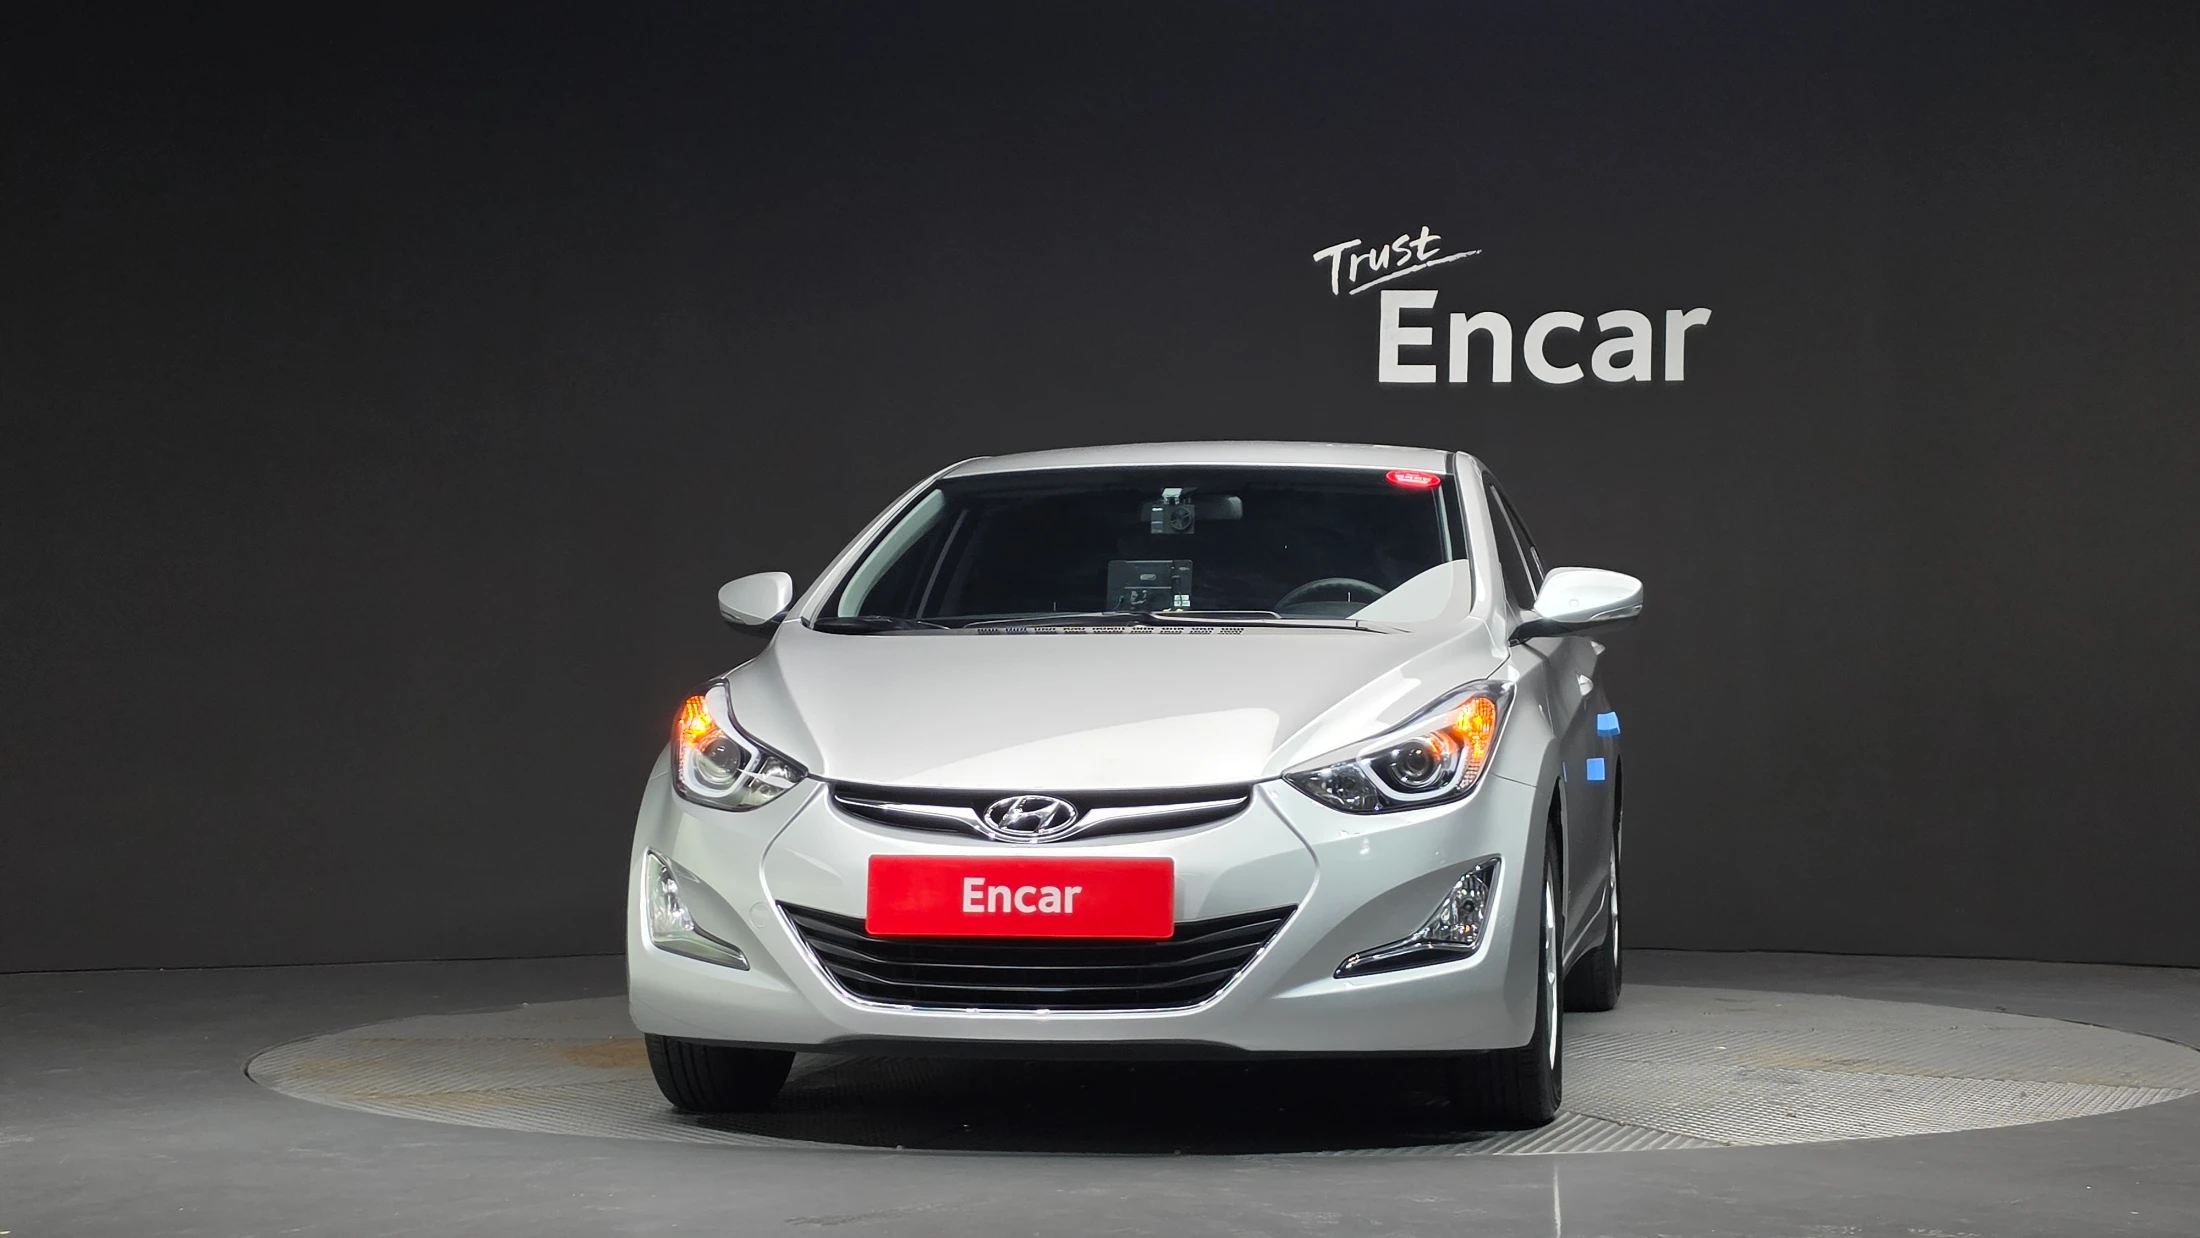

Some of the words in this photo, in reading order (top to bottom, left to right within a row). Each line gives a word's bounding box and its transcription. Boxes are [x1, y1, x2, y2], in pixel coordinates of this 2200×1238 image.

[1313, 226, 1442, 295] Trust
[1379, 289, 1712, 384] Encar
[962, 877, 1083, 914] Encar
